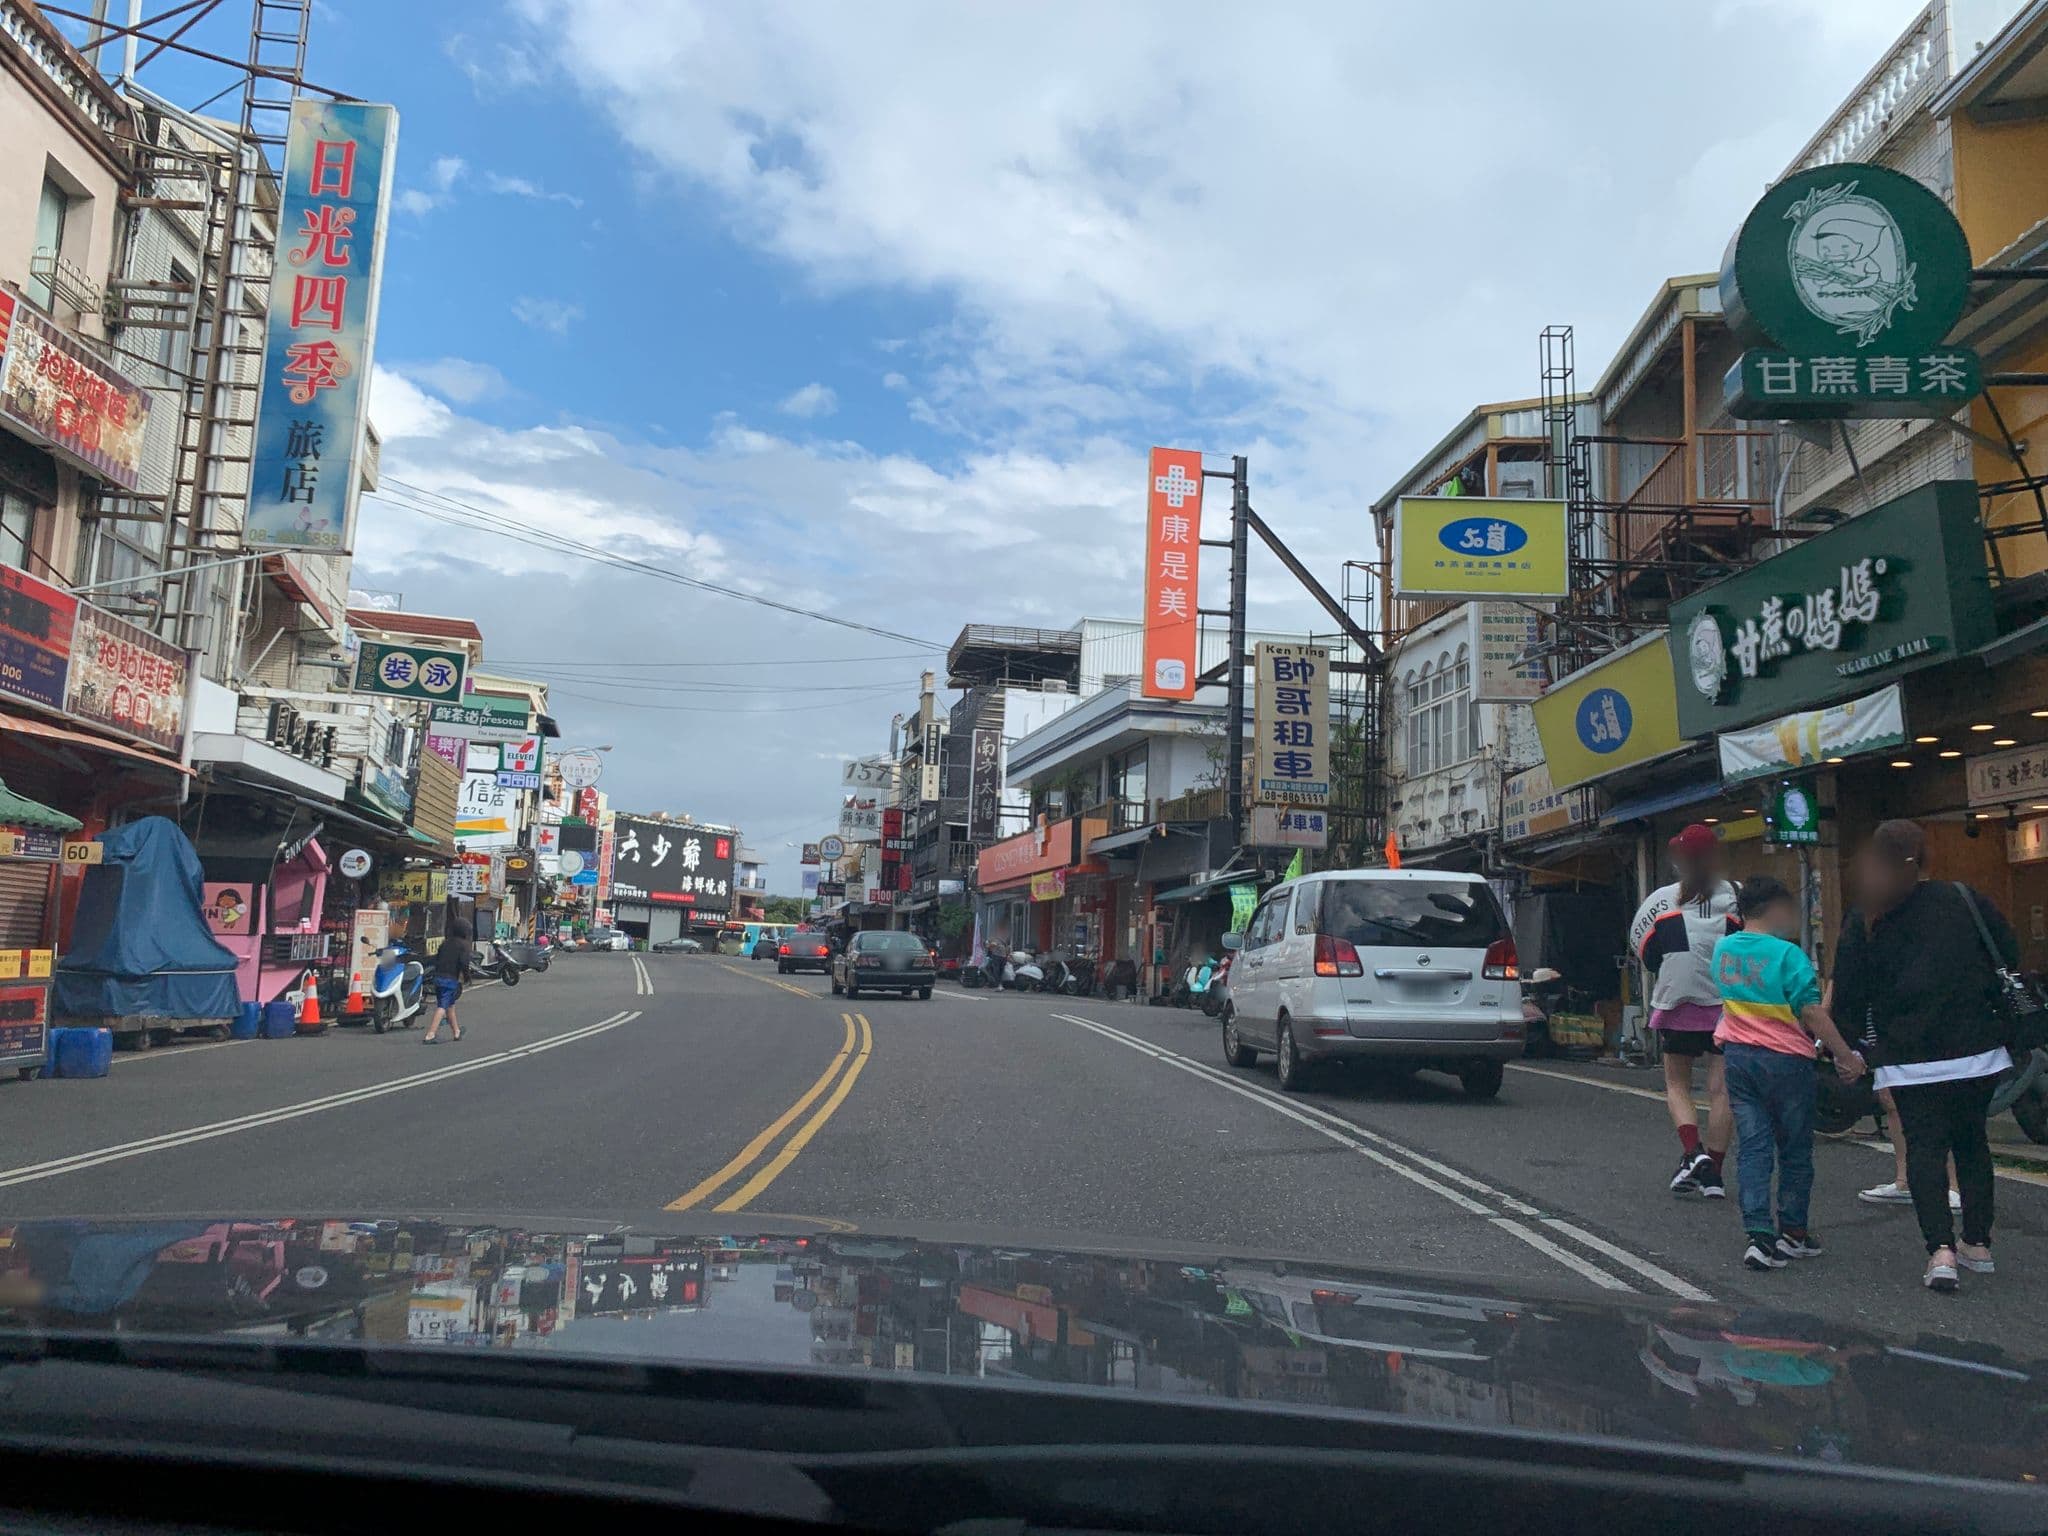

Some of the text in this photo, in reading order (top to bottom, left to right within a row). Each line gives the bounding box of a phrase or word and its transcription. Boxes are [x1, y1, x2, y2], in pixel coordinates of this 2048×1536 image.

[282, 138, 357, 405] 日光四季
[1755, 354, 1967, 395] 甘蔗青茶
[279, 418, 324, 505] 旅店
[1158, 513, 1190, 618] 康是美
[1732, 558, 1880, 677] 甘蔗の媽媽
[1266, 645, 1325, 659] Ken Ting
[1896, 637, 1931, 659] MAMA
[2, 663, 22, 681] DOG
[434, 706, 525, 728] 鮮茶道 presotea
[1273, 656, 1315, 780] 帥哥租車
[846, 762, 890, 781] 157
[976, 736, 998, 820] 南方太陽
[1279, 814, 1323, 832] 停車場
[67, 845, 88, 860] 60
[618, 829, 702, 872] 六少爺
